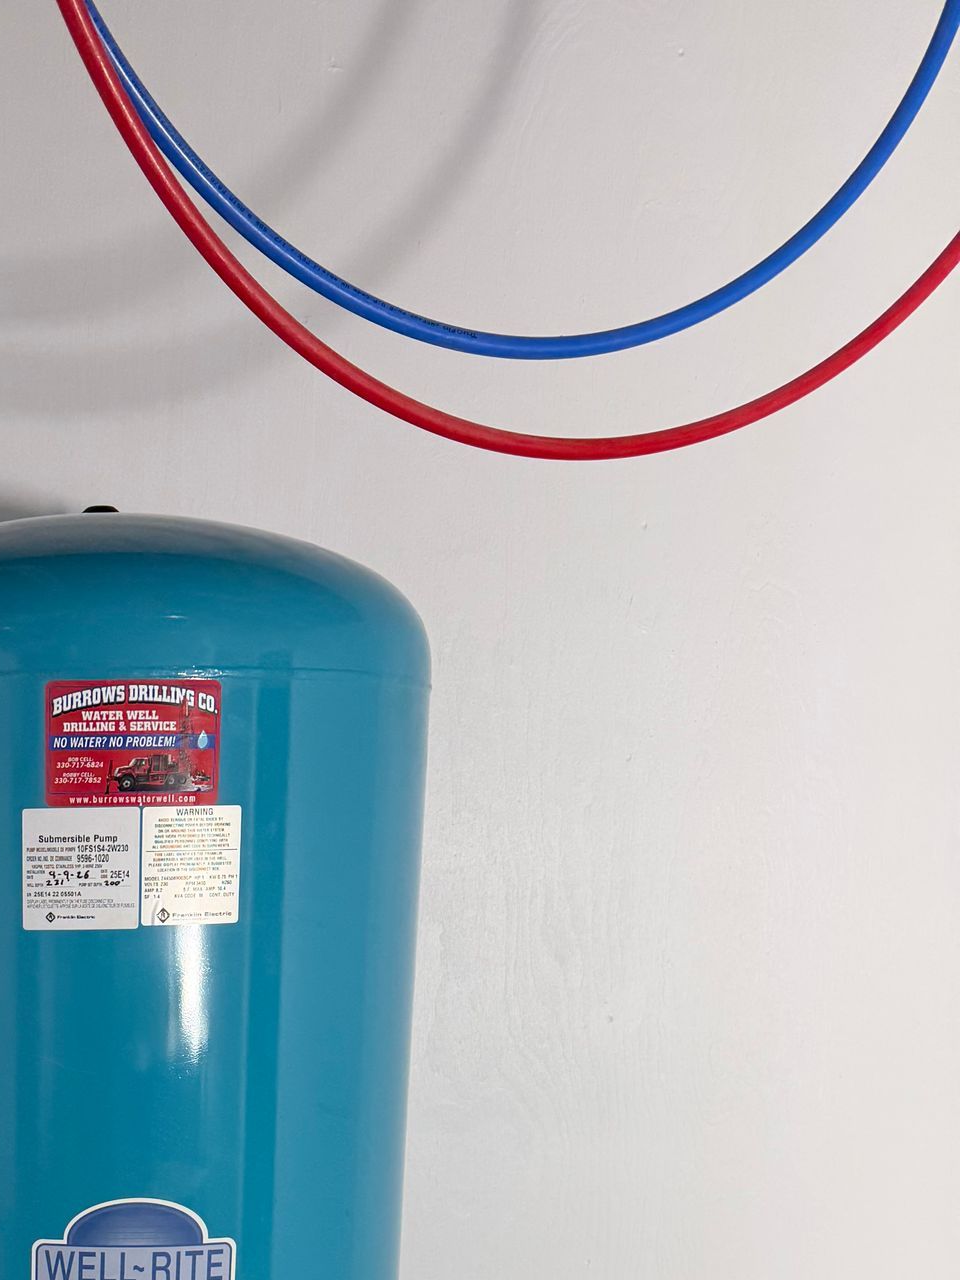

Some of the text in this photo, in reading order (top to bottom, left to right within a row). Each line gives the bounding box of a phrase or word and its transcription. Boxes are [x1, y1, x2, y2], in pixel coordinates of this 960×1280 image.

[52, 684, 218, 716] BURROWS DRILLING CO.
[82, 710, 159, 720] WATER WELL
[63, 721, 176, 732] DRILLING & SERVICE
[53, 736, 176, 748] NO WATER? NO PROBLEM!
[69, 794, 196, 804] www.burrowswaterwell.com
[38, 835, 118, 844] Submersible Pump
[77, 844, 128, 852] 10FS1S4-2W230
[76, 854, 110, 862] 9596-1020
[110, 870, 130, 878] 25E14
